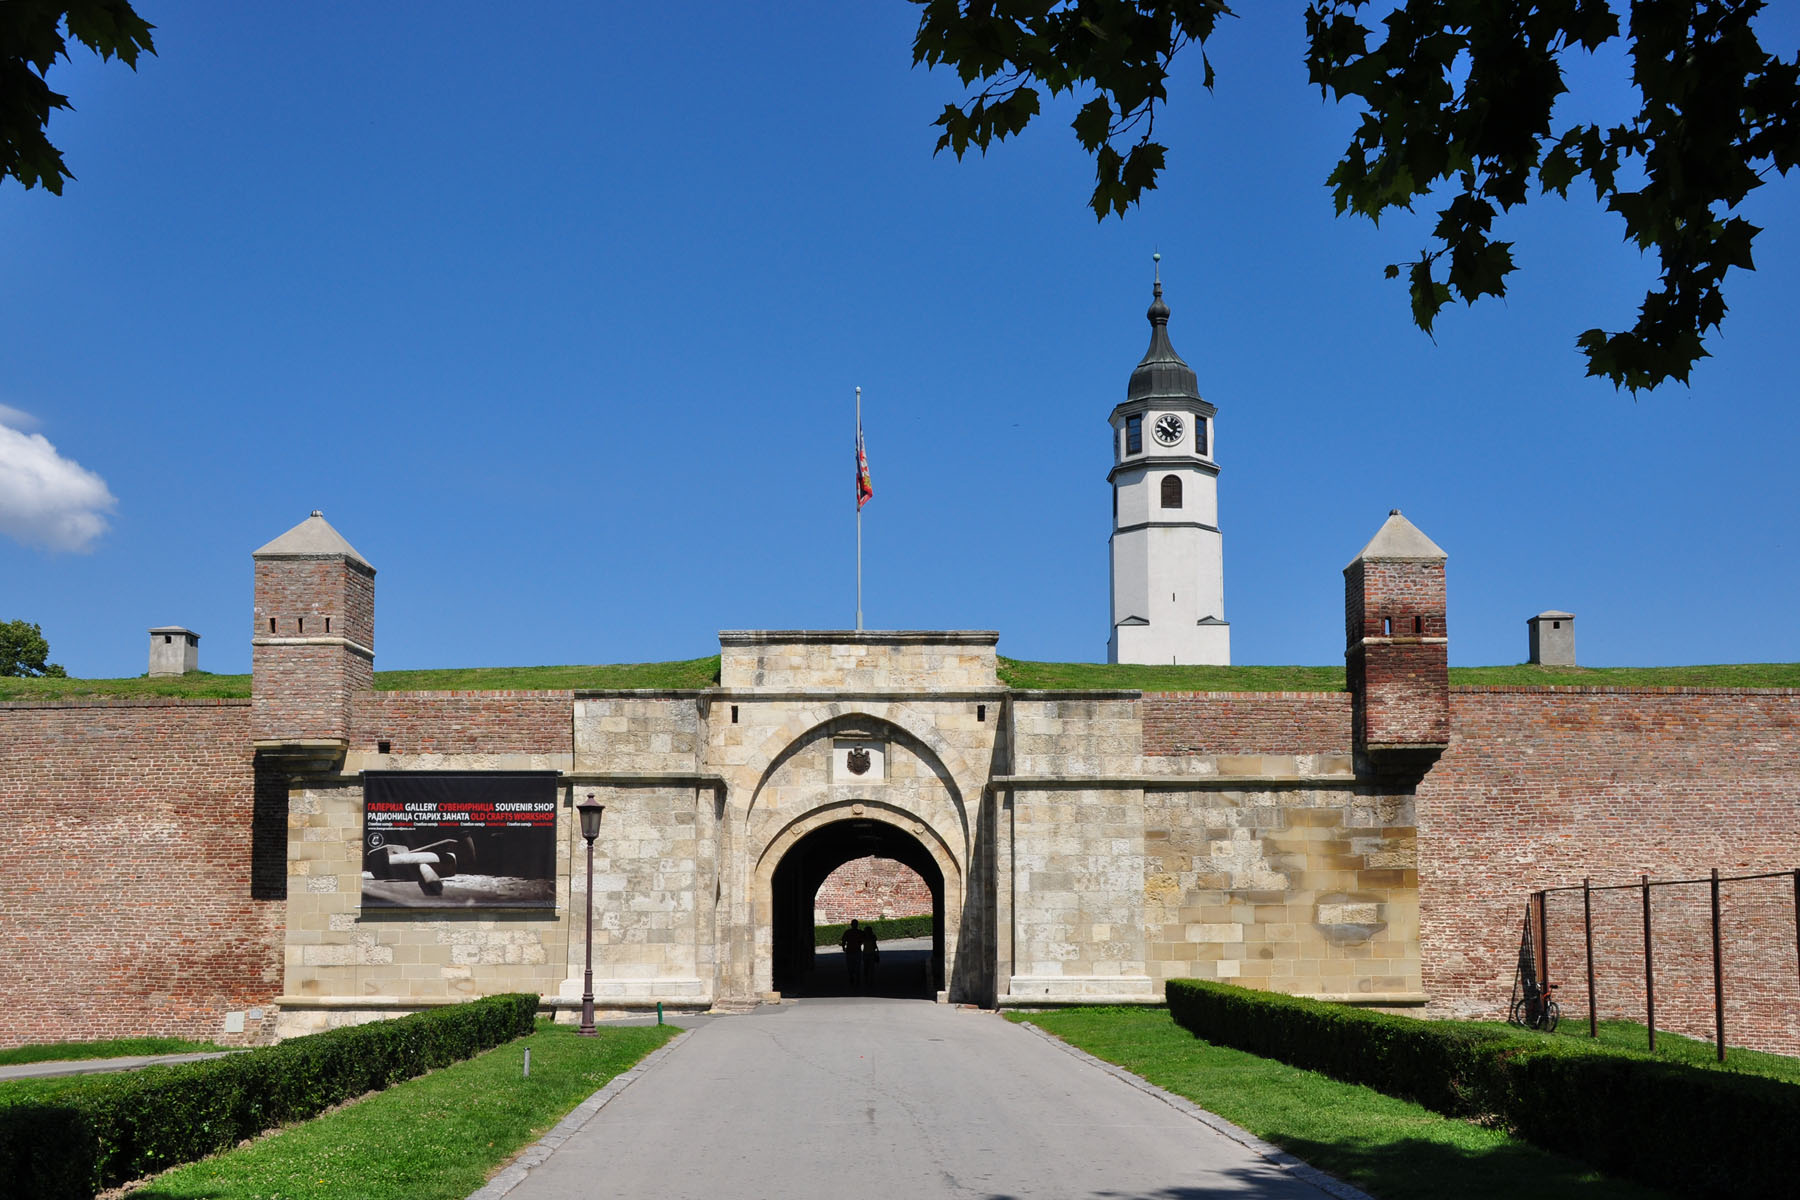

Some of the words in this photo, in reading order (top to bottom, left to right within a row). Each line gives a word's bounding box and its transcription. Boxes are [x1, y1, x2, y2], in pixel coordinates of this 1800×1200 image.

[368, 802, 404, 811] ГАЛЕРИЈА
[405, 802, 437, 811] GALLERY
[438, 802, 494, 812] СУВЕНИРНИЦА
[495, 802, 532, 811] SOUVENIR
[533, 802, 554, 811] SHOP
[368, 812, 412, 822] РАДИОНИЦА
[413, 812, 441, 820] СТАРИХ
[442, 812, 470, 820] ЗАНАТА
[470, 812, 485, 820] OLD
[486, 812, 512, 820] CRAFTS
[514, 812, 555, 820] WORKSHOP
